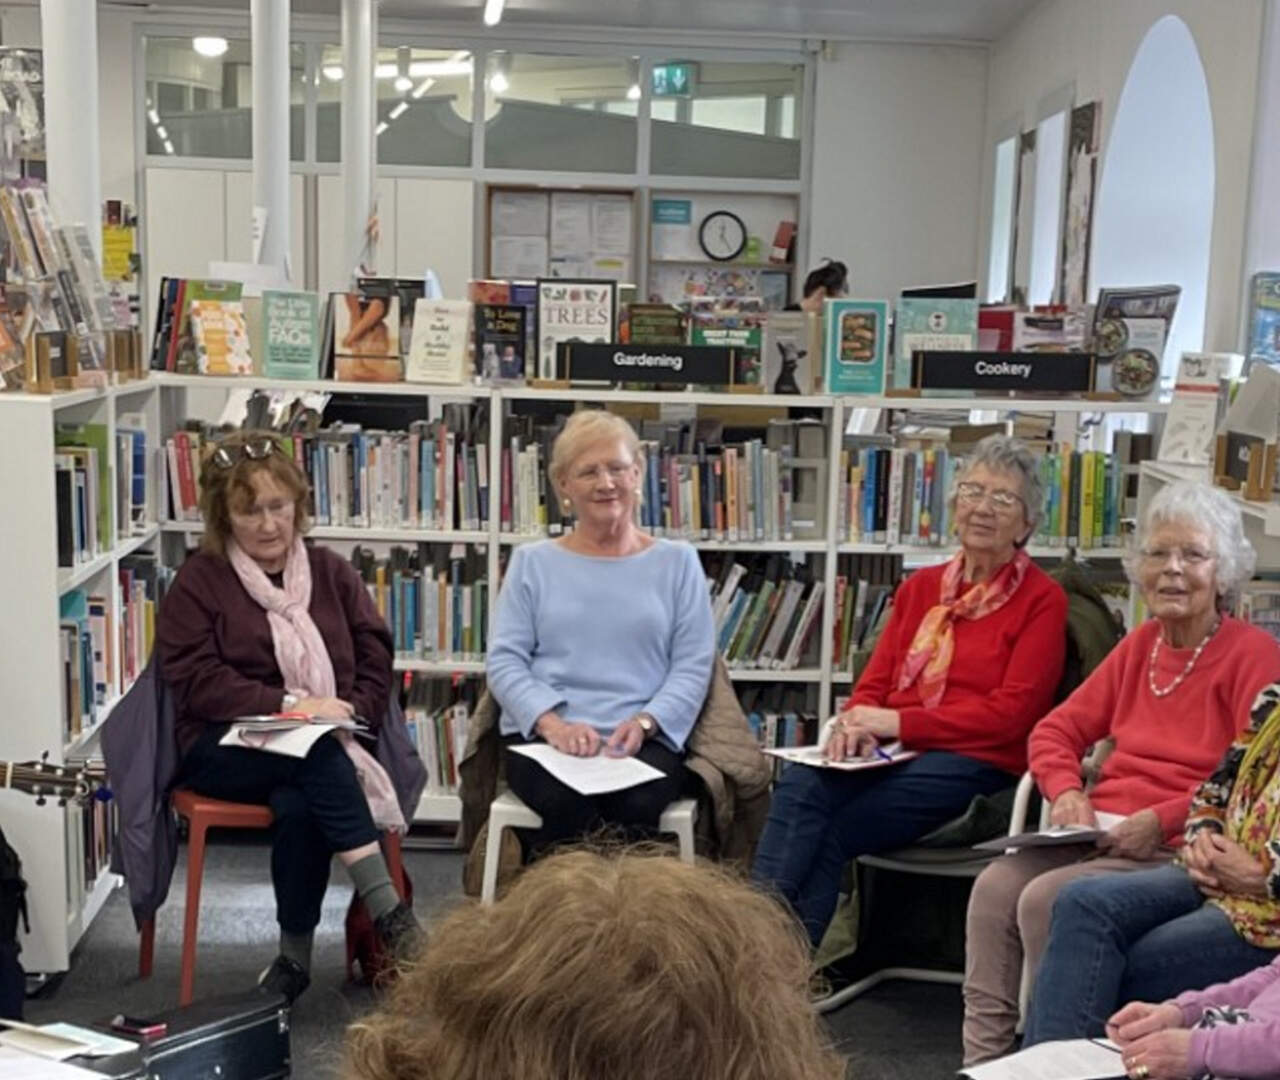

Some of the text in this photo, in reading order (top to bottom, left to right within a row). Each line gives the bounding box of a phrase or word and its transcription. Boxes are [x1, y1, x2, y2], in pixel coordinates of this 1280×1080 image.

[543, 307, 608, 326] TREES
[613, 351, 683, 372] Gardening
[975, 361, 1032, 378] Cookery
